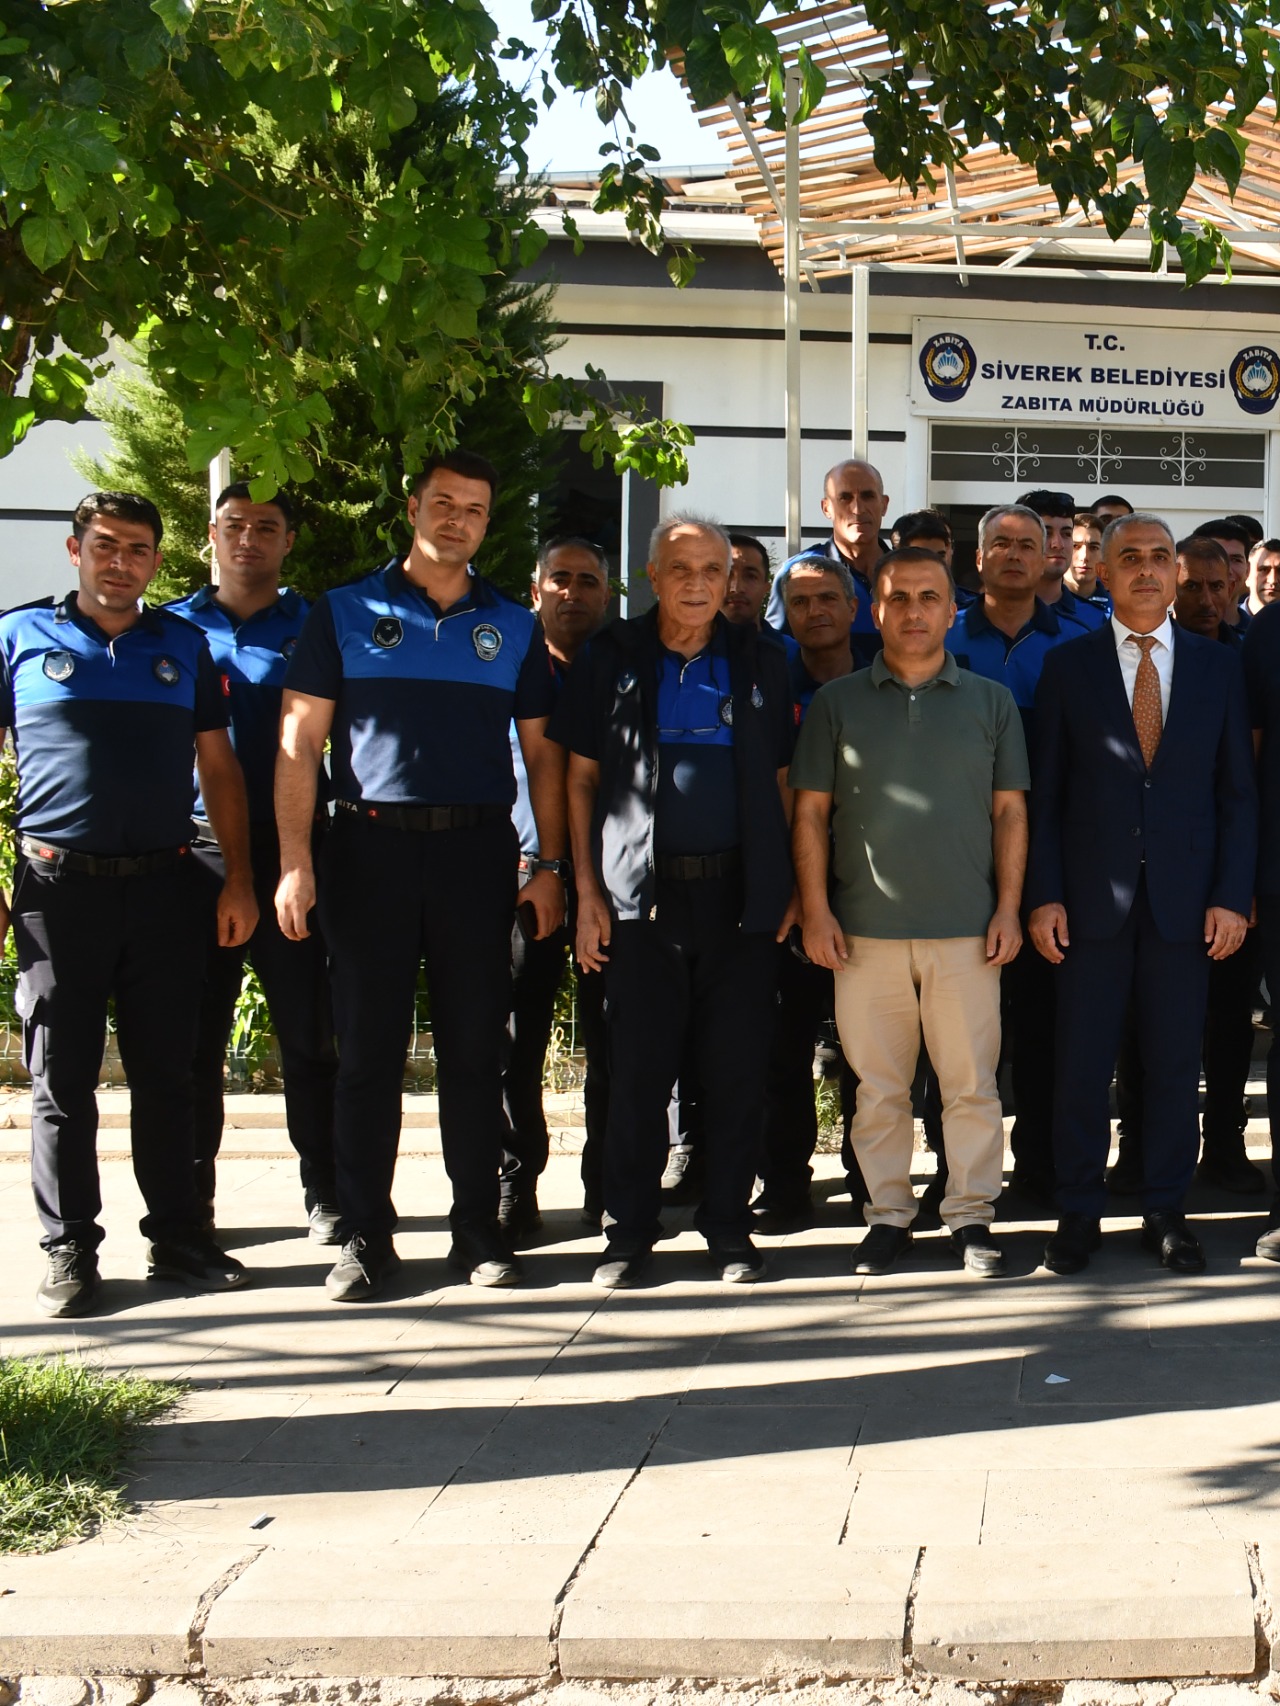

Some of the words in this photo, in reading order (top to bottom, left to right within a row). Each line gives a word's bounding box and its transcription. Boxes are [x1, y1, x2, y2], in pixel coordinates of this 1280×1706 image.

[933, 336, 964, 348] ZABITA
[1083, 333, 1126, 352] T.C.
[1243, 349, 1273, 362] ZABITA
[980, 359, 1083, 383] SİVEREK
[1090, 366, 1226, 389] BELEDİYESİ
[1001, 395, 1073, 412] ZABITA
[1079, 398, 1205, 417] MÜDÜRLÜĞÜ
